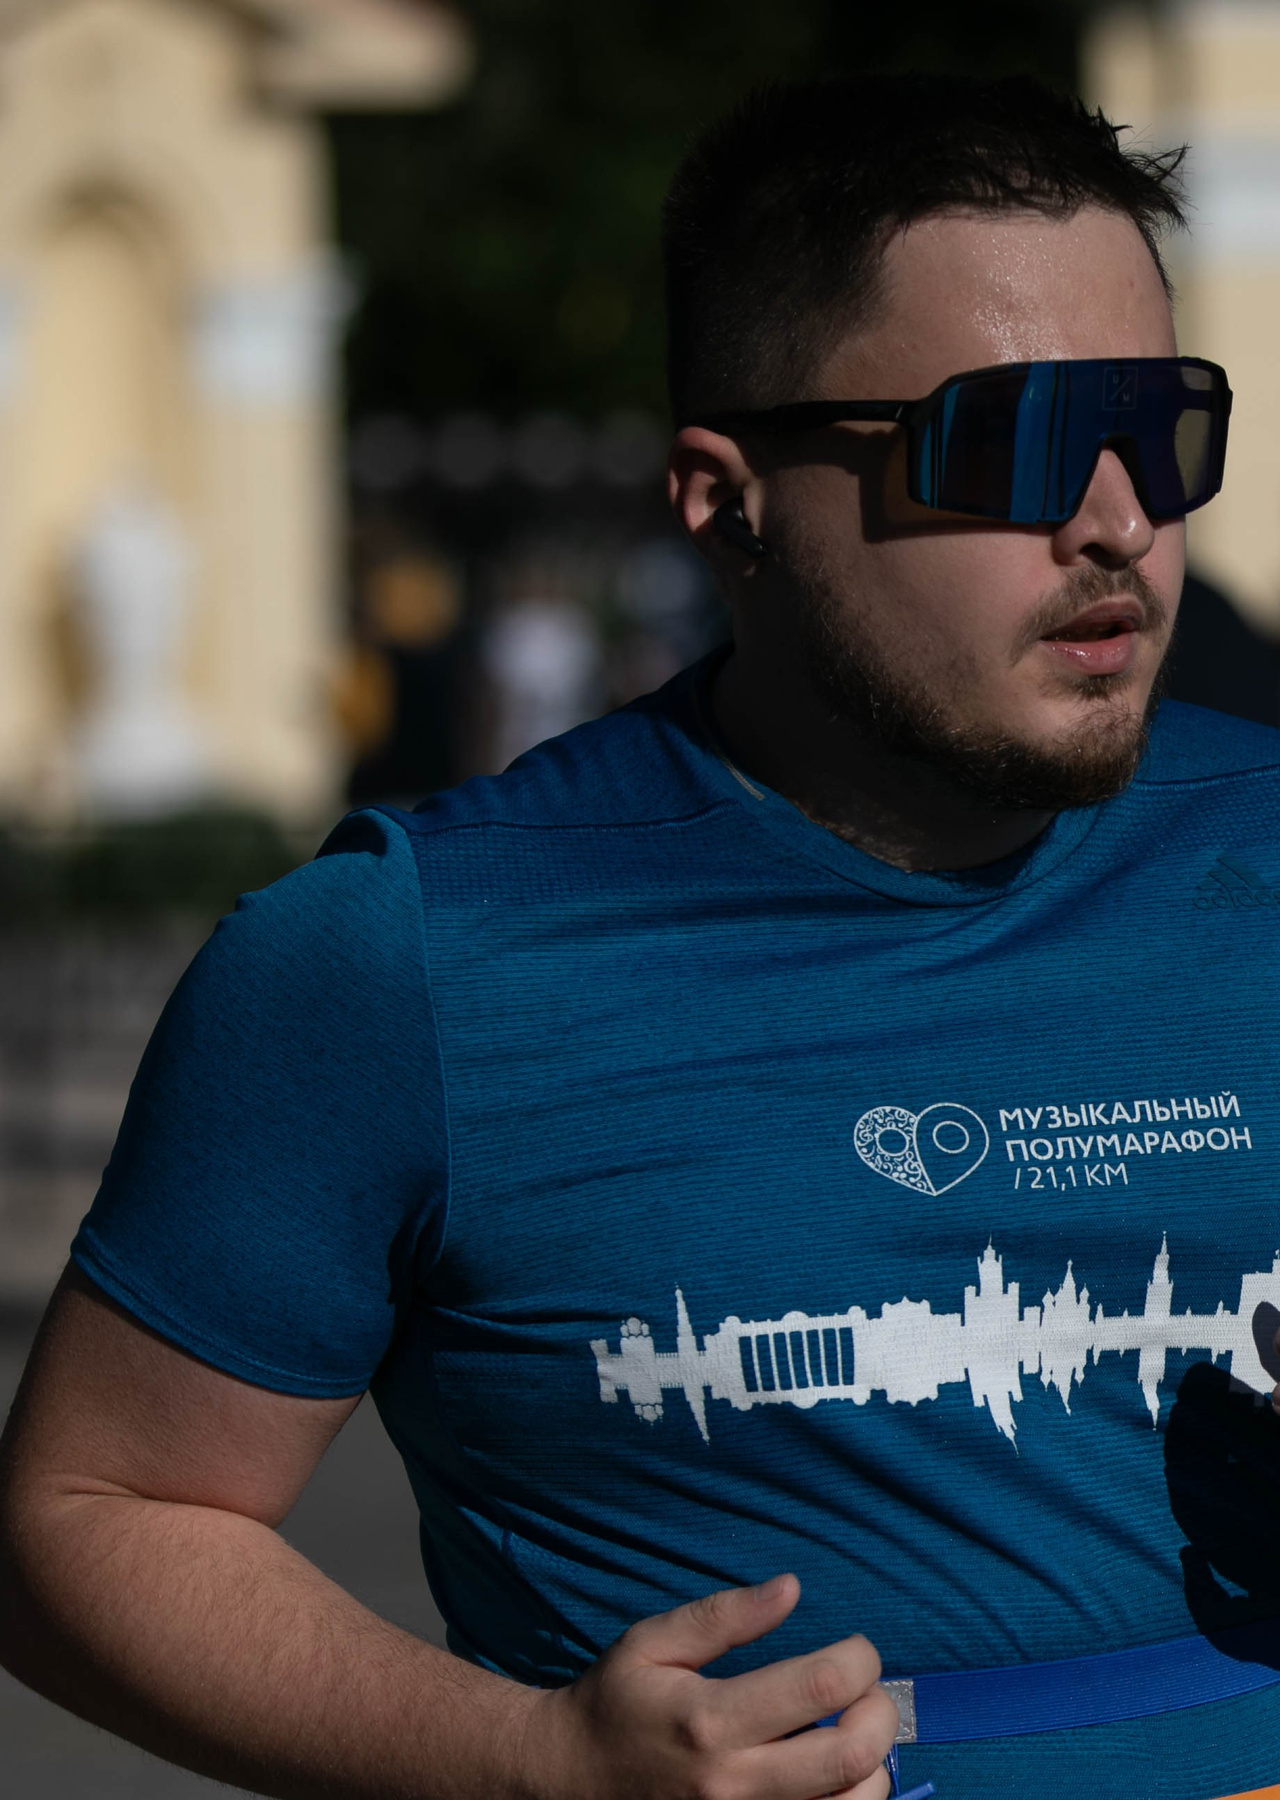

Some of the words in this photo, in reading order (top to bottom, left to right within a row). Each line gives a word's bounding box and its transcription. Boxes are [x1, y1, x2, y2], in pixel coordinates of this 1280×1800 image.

[999, 1090, 1241, 1132] МУЗЫКАЛЬНЫЙ
[1005, 1126, 1253, 1162] ПОЛУМАРАФОН
[1084, 1162, 1129, 1187] КМ
